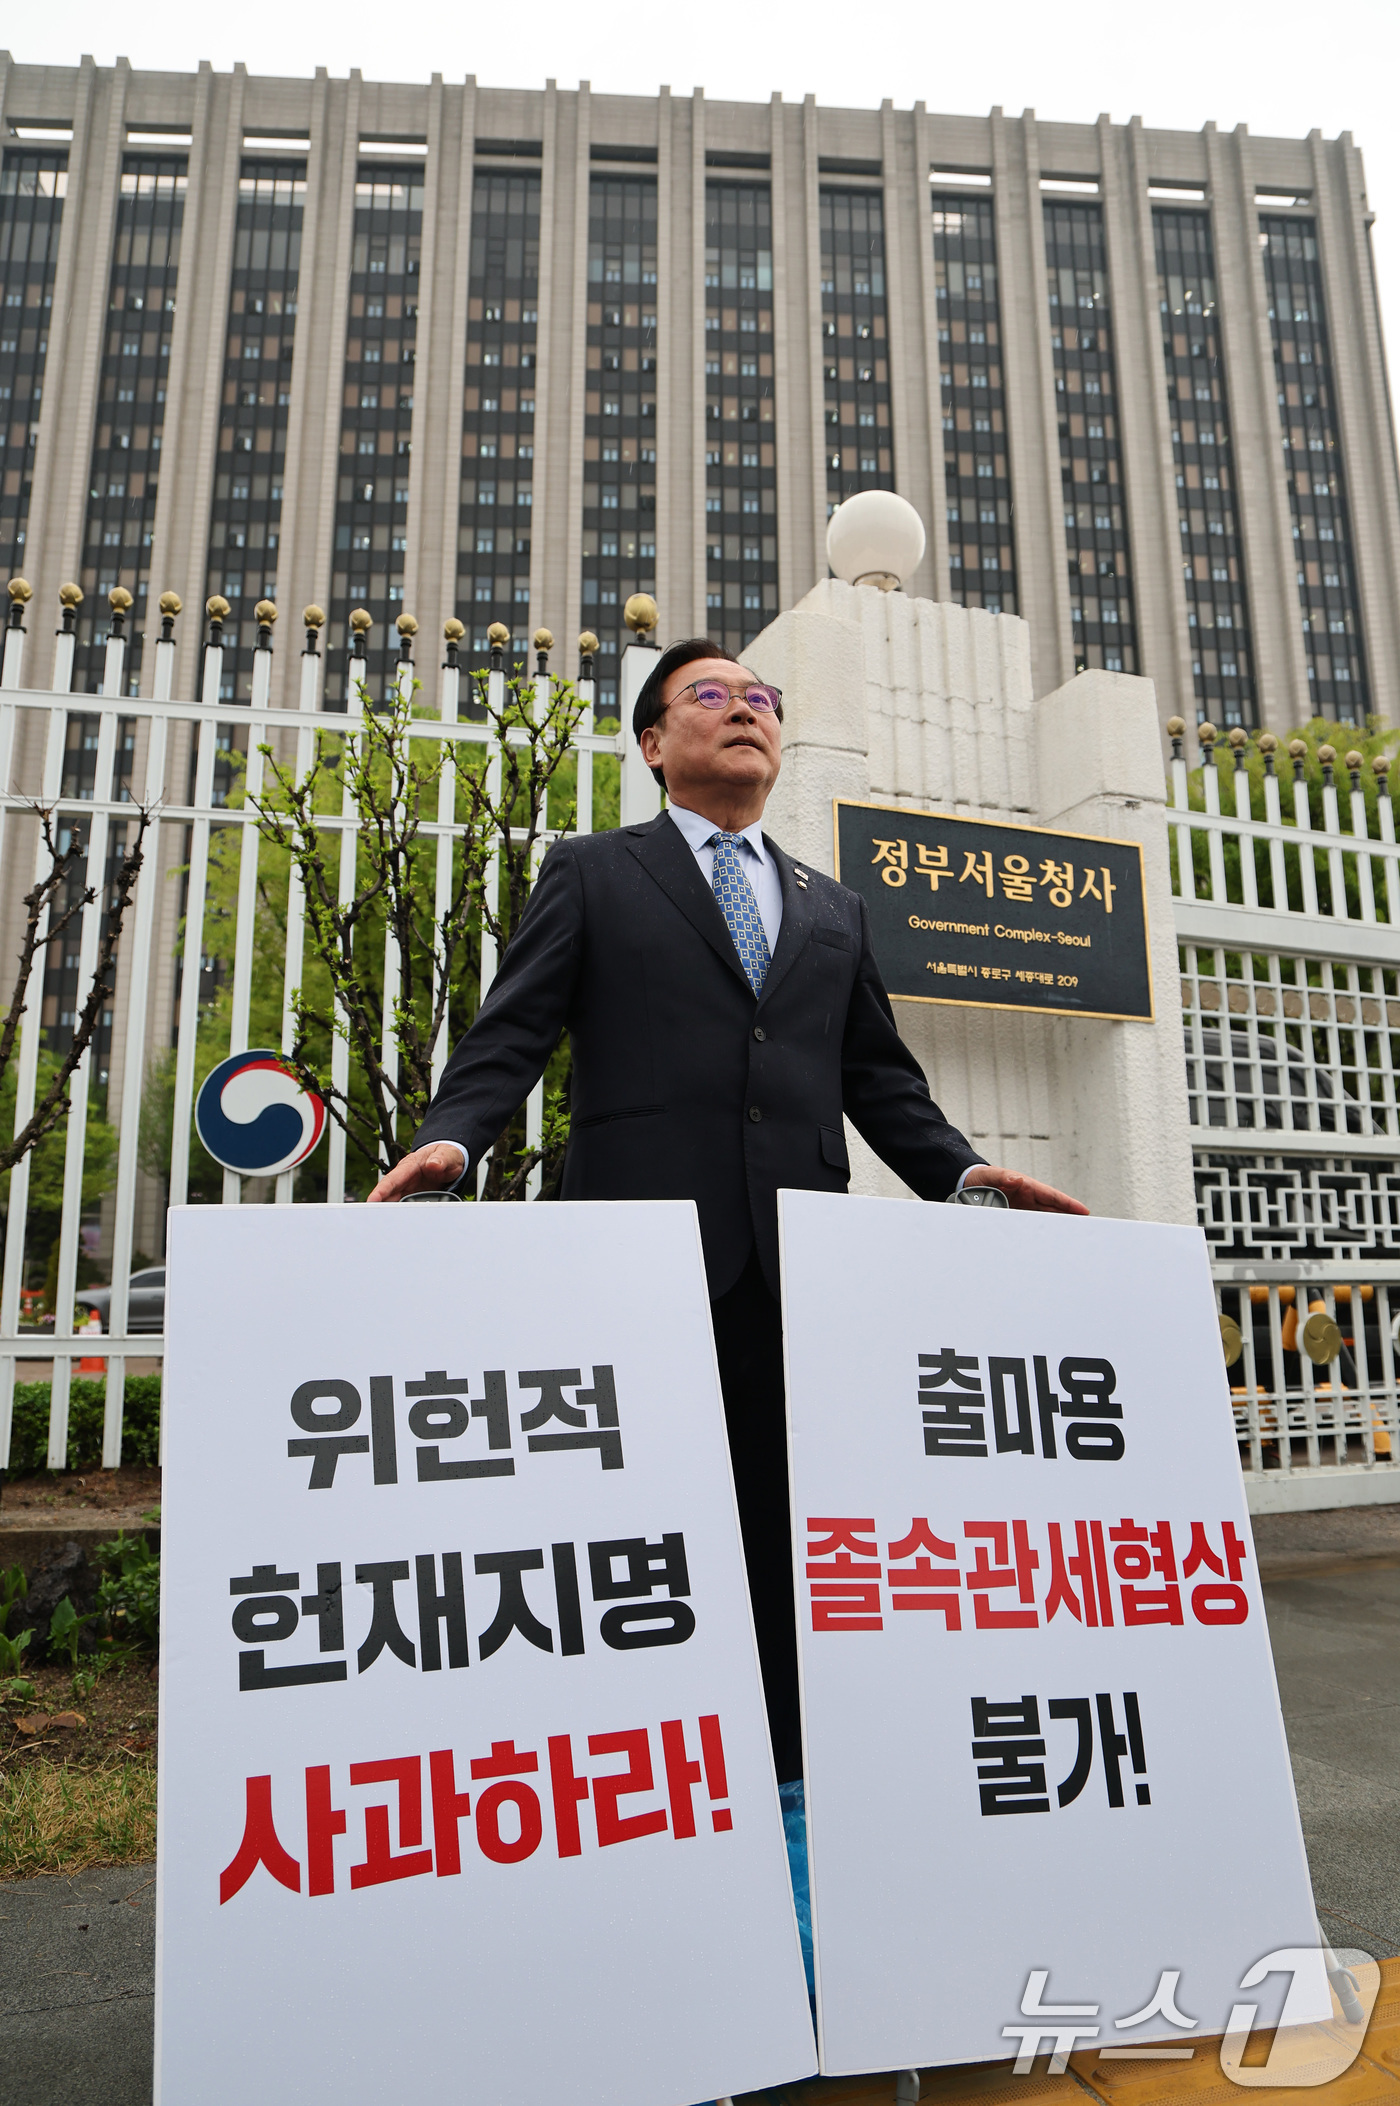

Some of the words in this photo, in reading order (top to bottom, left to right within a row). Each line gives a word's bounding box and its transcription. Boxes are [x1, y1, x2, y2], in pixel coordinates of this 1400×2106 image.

[871, 838, 1117, 914] 정부서울청사
[908, 914, 990, 937] Government
[993, 924, 1092, 948] Complex-Seoul
[926, 961, 978, 978] 서울특별시
[980, 966, 1012, 981] 종로구
[1015, 970, 1054, 985] 세종대로
[1057, 974, 1079, 988] 209
[288, 1364, 625, 1490] 위헌적
[917, 1347, 1126, 1461] 출마용
[229, 1531, 696, 1692] 헌재지명
[805, 1517, 1249, 1632] 졸속관세협상
[219, 1714, 733, 1906] 사과하라!
[970, 1691, 1152, 1817] 불가!
